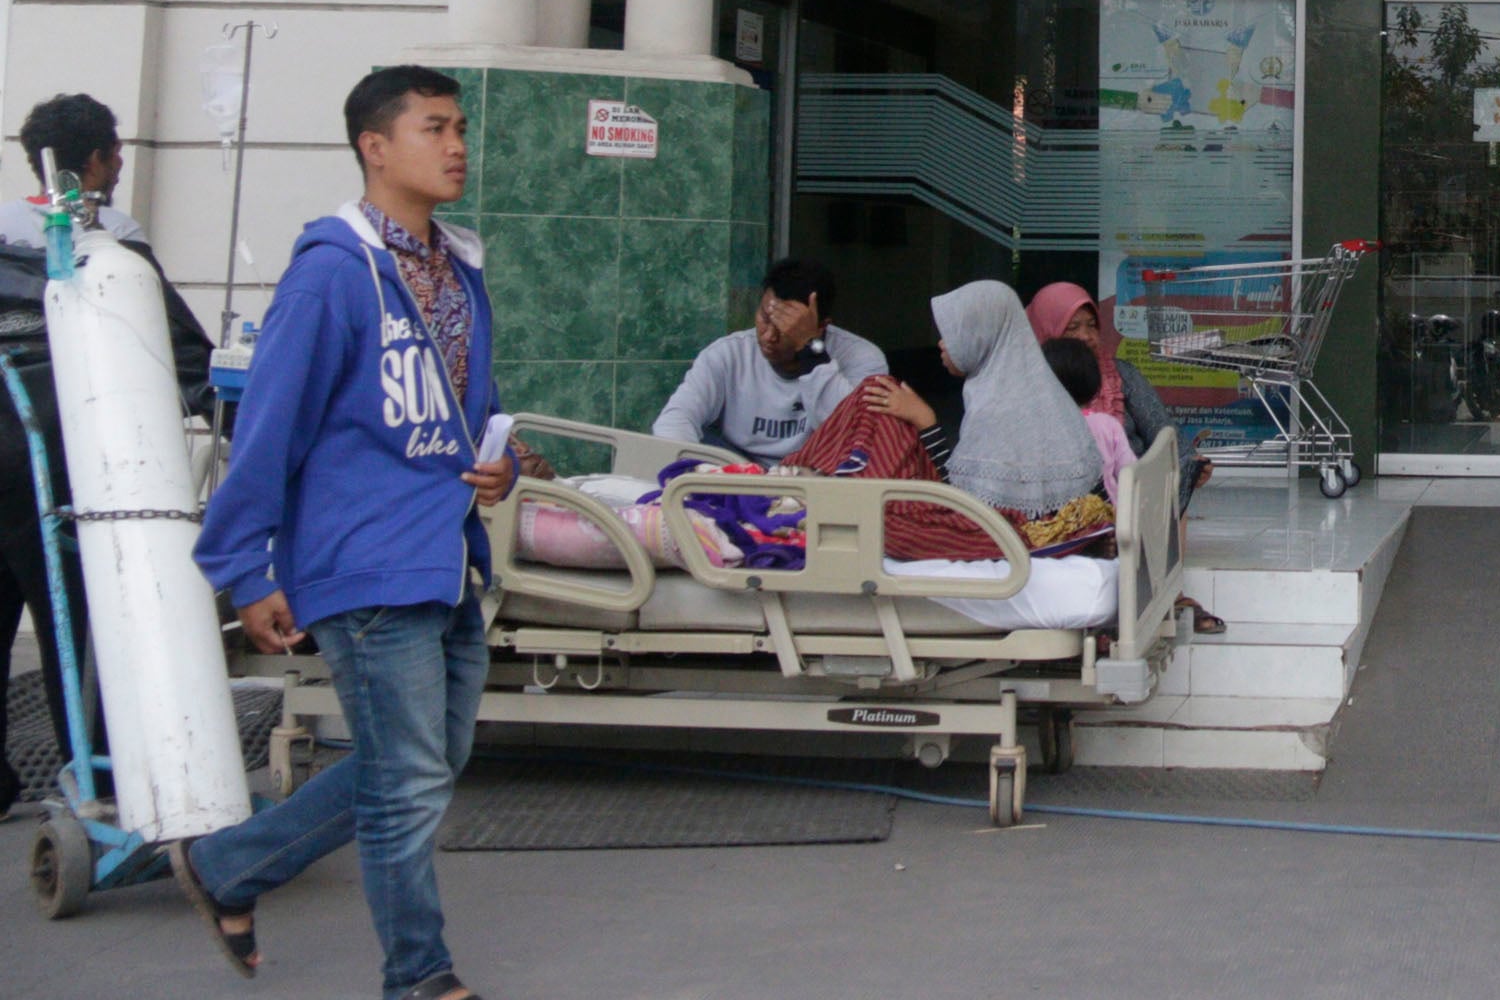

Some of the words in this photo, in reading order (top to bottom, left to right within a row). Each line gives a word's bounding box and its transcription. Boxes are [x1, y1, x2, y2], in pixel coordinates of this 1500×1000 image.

[591, 125, 605, 141] NO
[608, 126, 654, 143] SMOKING
[752, 416, 807, 439] PUMA
[406, 426, 460, 459] like
[852, 708, 917, 725] Platinum
